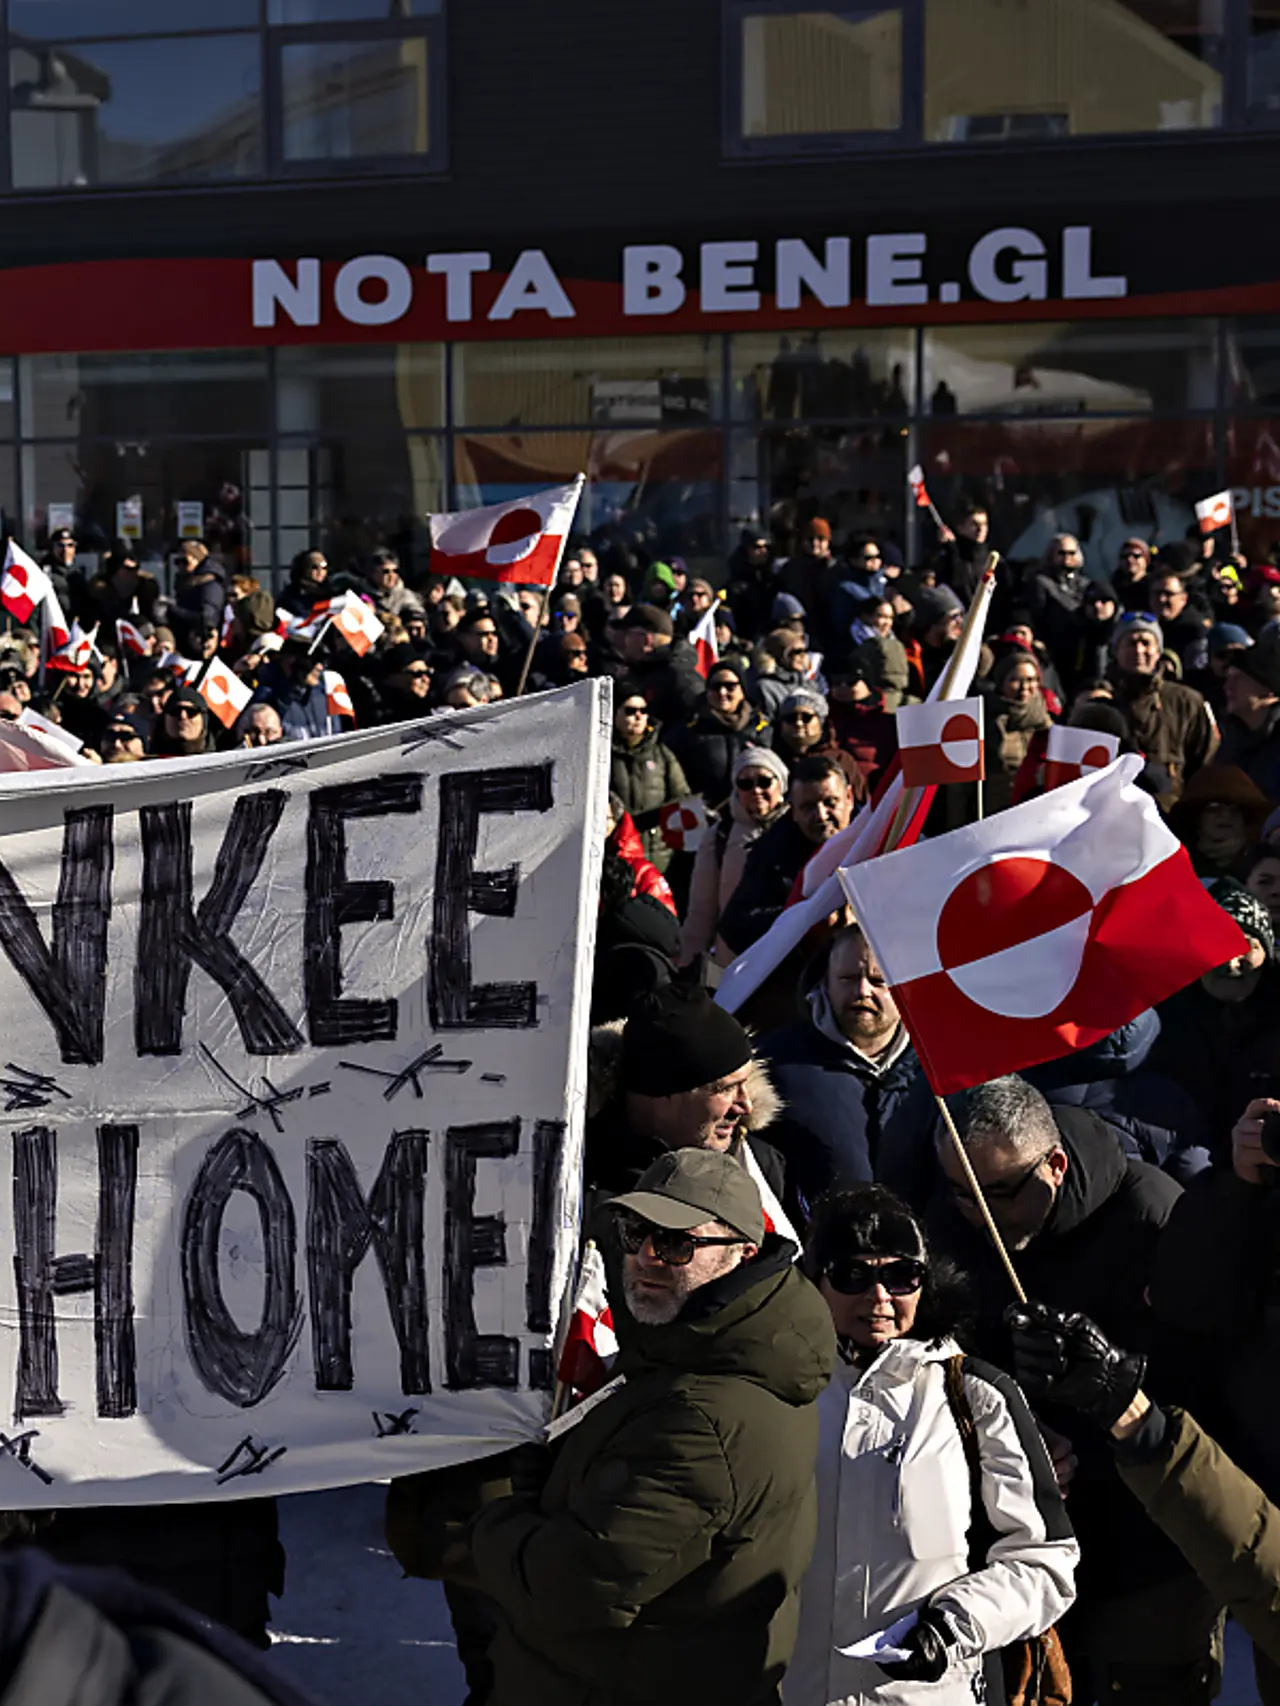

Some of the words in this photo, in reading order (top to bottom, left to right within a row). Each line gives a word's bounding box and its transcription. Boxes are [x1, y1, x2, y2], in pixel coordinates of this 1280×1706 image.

[252, 249, 577, 328] NOTA
[623, 226, 1127, 316] BENE.GL
[11, 1116, 568, 1425] HOME!
